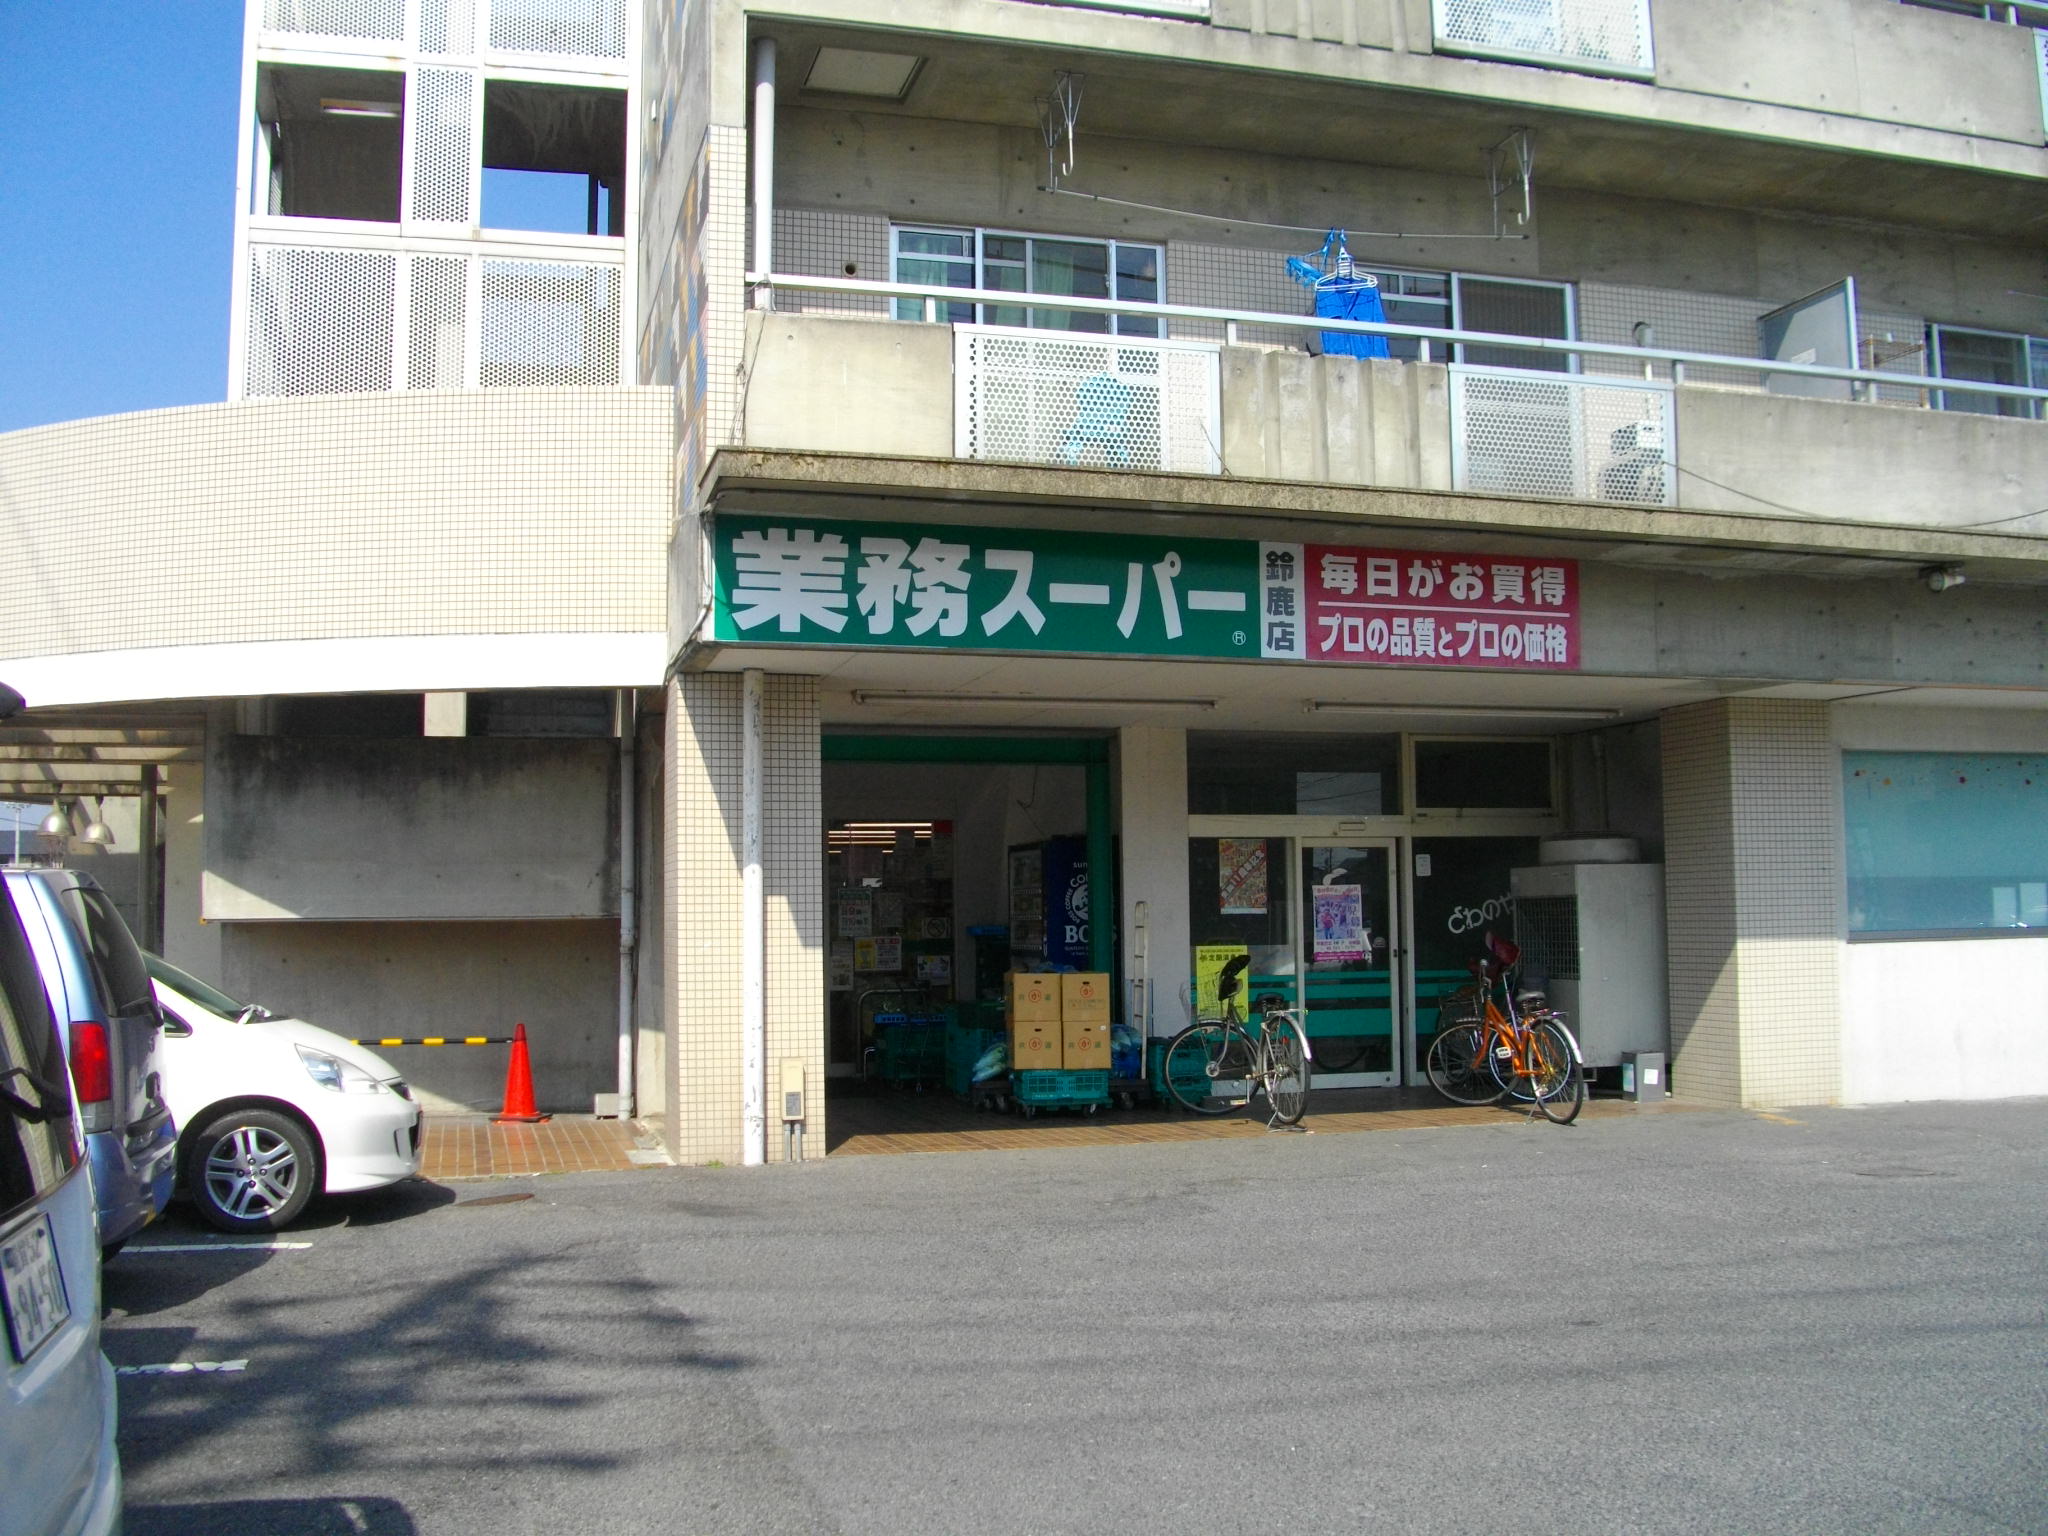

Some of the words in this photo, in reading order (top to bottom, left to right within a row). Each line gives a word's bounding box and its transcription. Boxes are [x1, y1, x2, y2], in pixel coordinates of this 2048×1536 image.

[732, 528, 1246, 640] 業務スーパー
[1266, 551, 1295, 652] 鈴鹿店
[1320, 553, 1566, 606] 毎日がお買得
[1318, 612, 1567, 663] プロの品質とプロの価格
